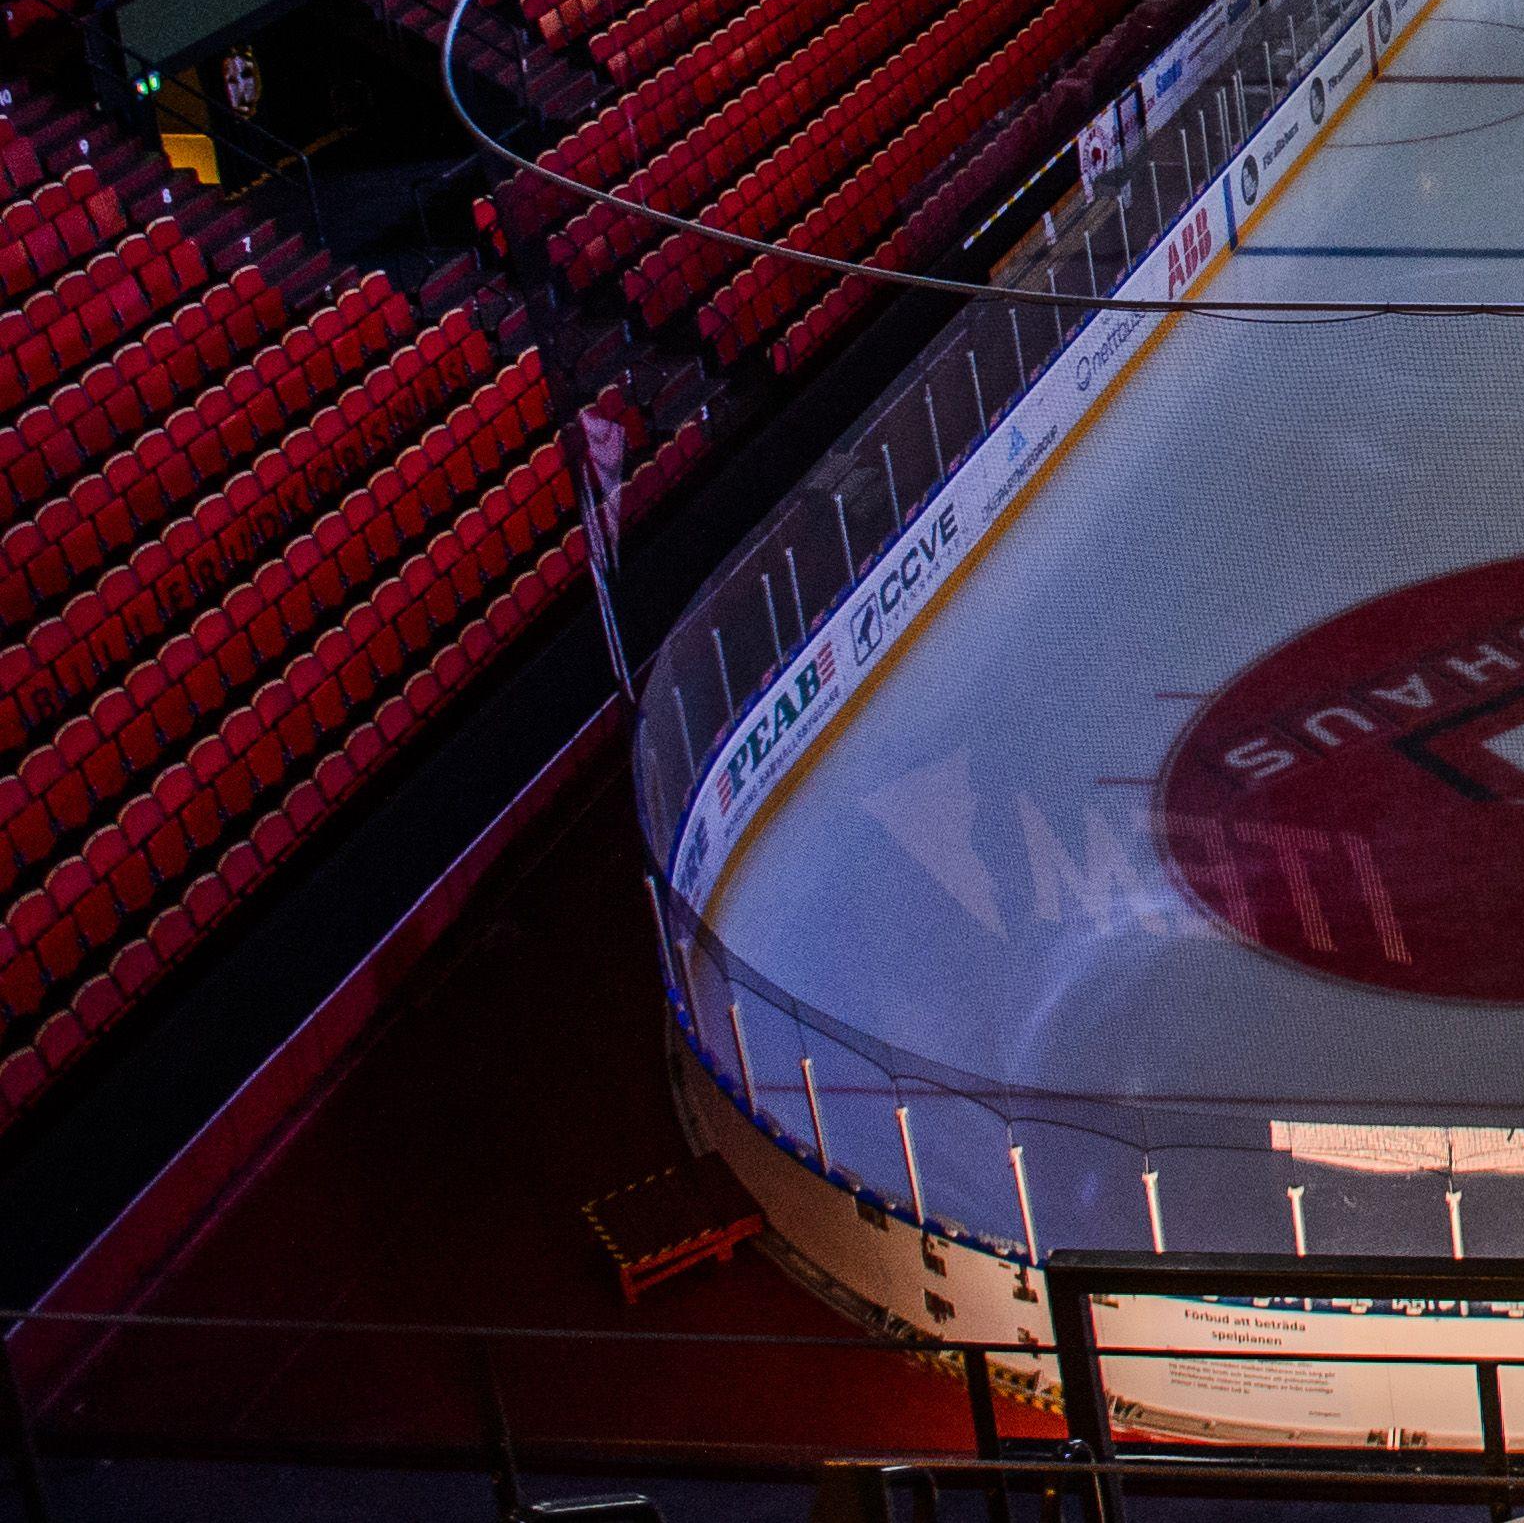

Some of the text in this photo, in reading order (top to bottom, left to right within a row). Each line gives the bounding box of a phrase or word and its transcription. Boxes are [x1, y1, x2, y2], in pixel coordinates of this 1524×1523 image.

[1166, 208, 1212, 299] ABB
[727, 658, 824, 797] PEAB
[1184, 1307, 1307, 1333] Förbud att beträda
[1211, 1328, 1282, 1347] spelplanen
